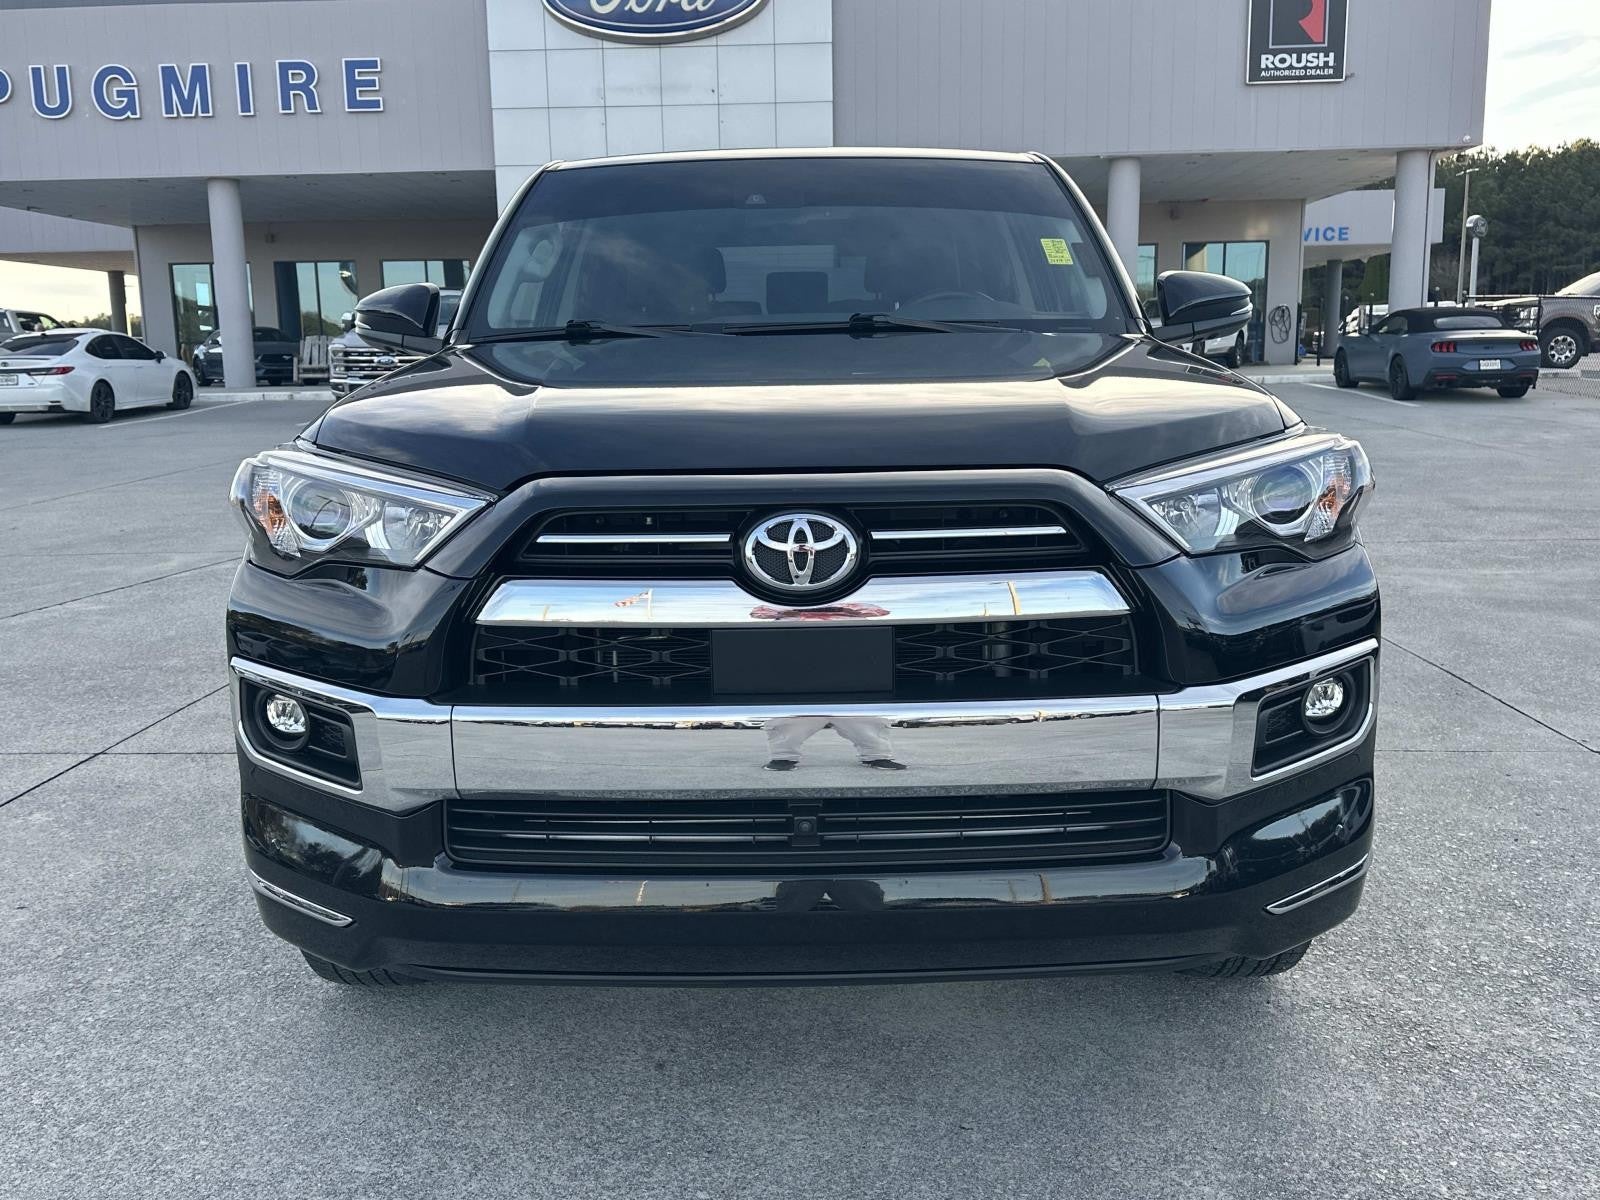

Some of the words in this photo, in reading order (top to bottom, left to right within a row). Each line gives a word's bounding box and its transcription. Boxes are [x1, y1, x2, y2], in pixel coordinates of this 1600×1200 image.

[1260, 52, 1335, 69] ROUSH
[1260, 69, 1306, 77] AUTHORIZED
[1306, 68, 1334, 76] DEALER
[0, 57, 384, 120] UGMIRE
